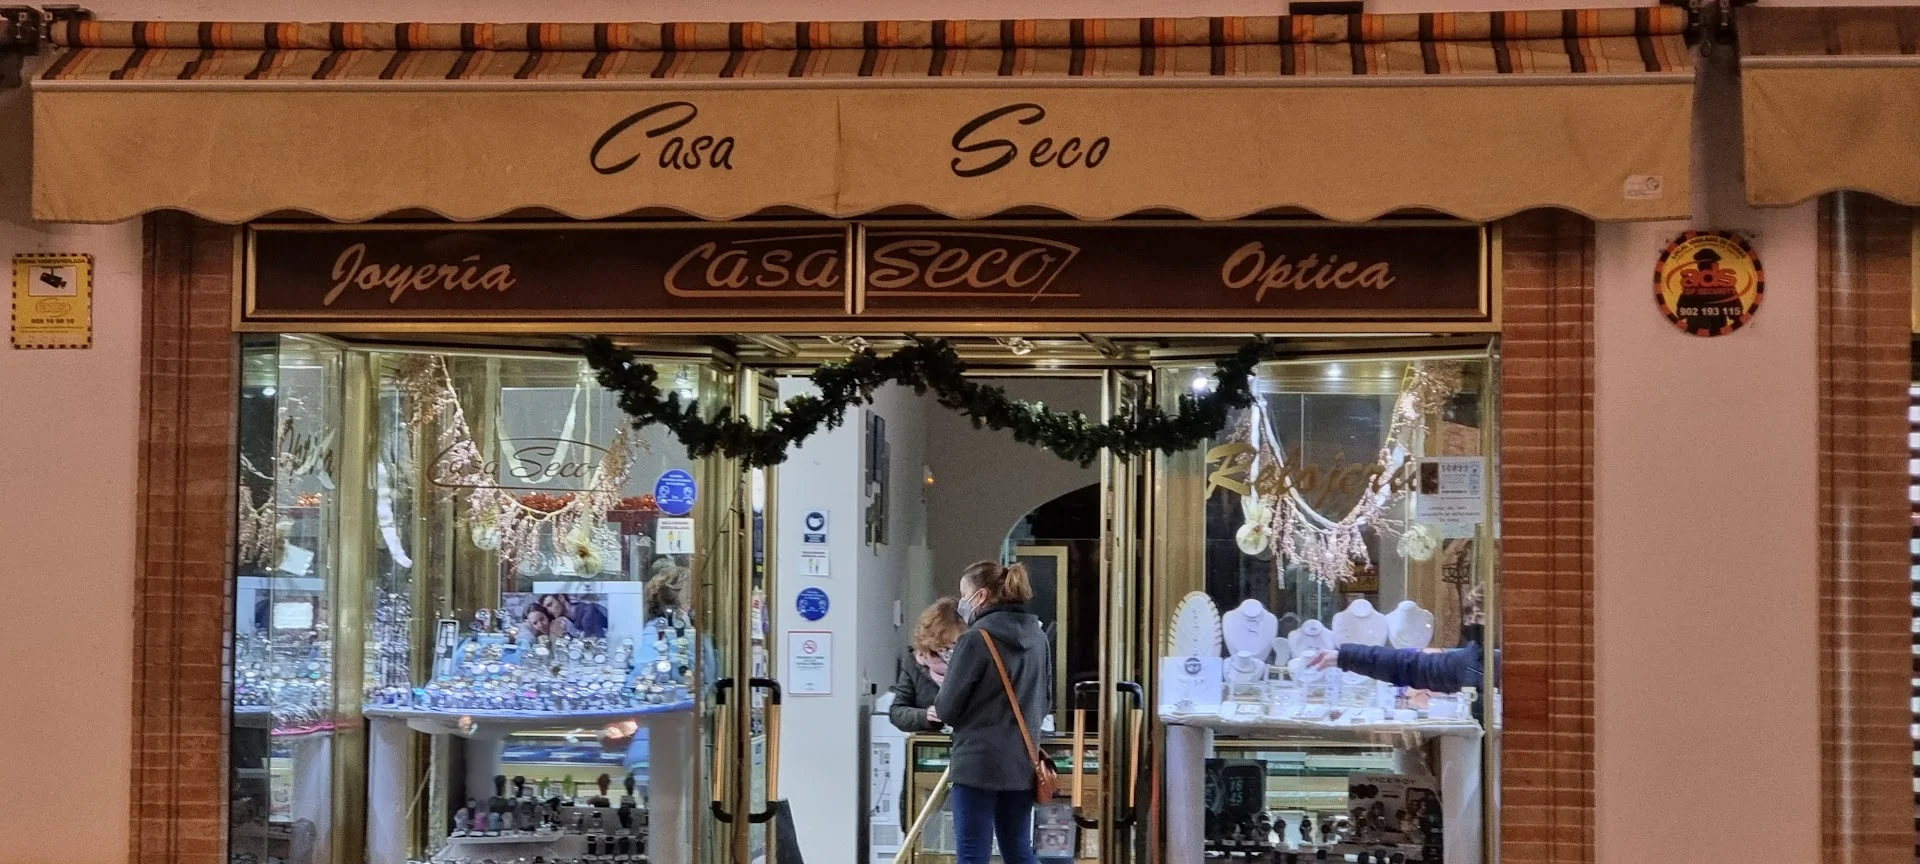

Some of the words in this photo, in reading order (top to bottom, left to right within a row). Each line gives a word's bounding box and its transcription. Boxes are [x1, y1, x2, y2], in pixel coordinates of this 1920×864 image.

[590, 101, 735, 175] Casa
[950, 103, 1110, 177] Seco
[324, 243, 517, 306] Joyería
[664, 241, 841, 297] Casa
[868, 239, 1057, 289] Seco
[1222, 241, 1396, 303] Optica
[1680, 307, 1699, 316] 902
[1701, 307, 1720, 316] 193
[1722, 307, 1741, 316] 115
[510, 446, 600, 478] Seco
